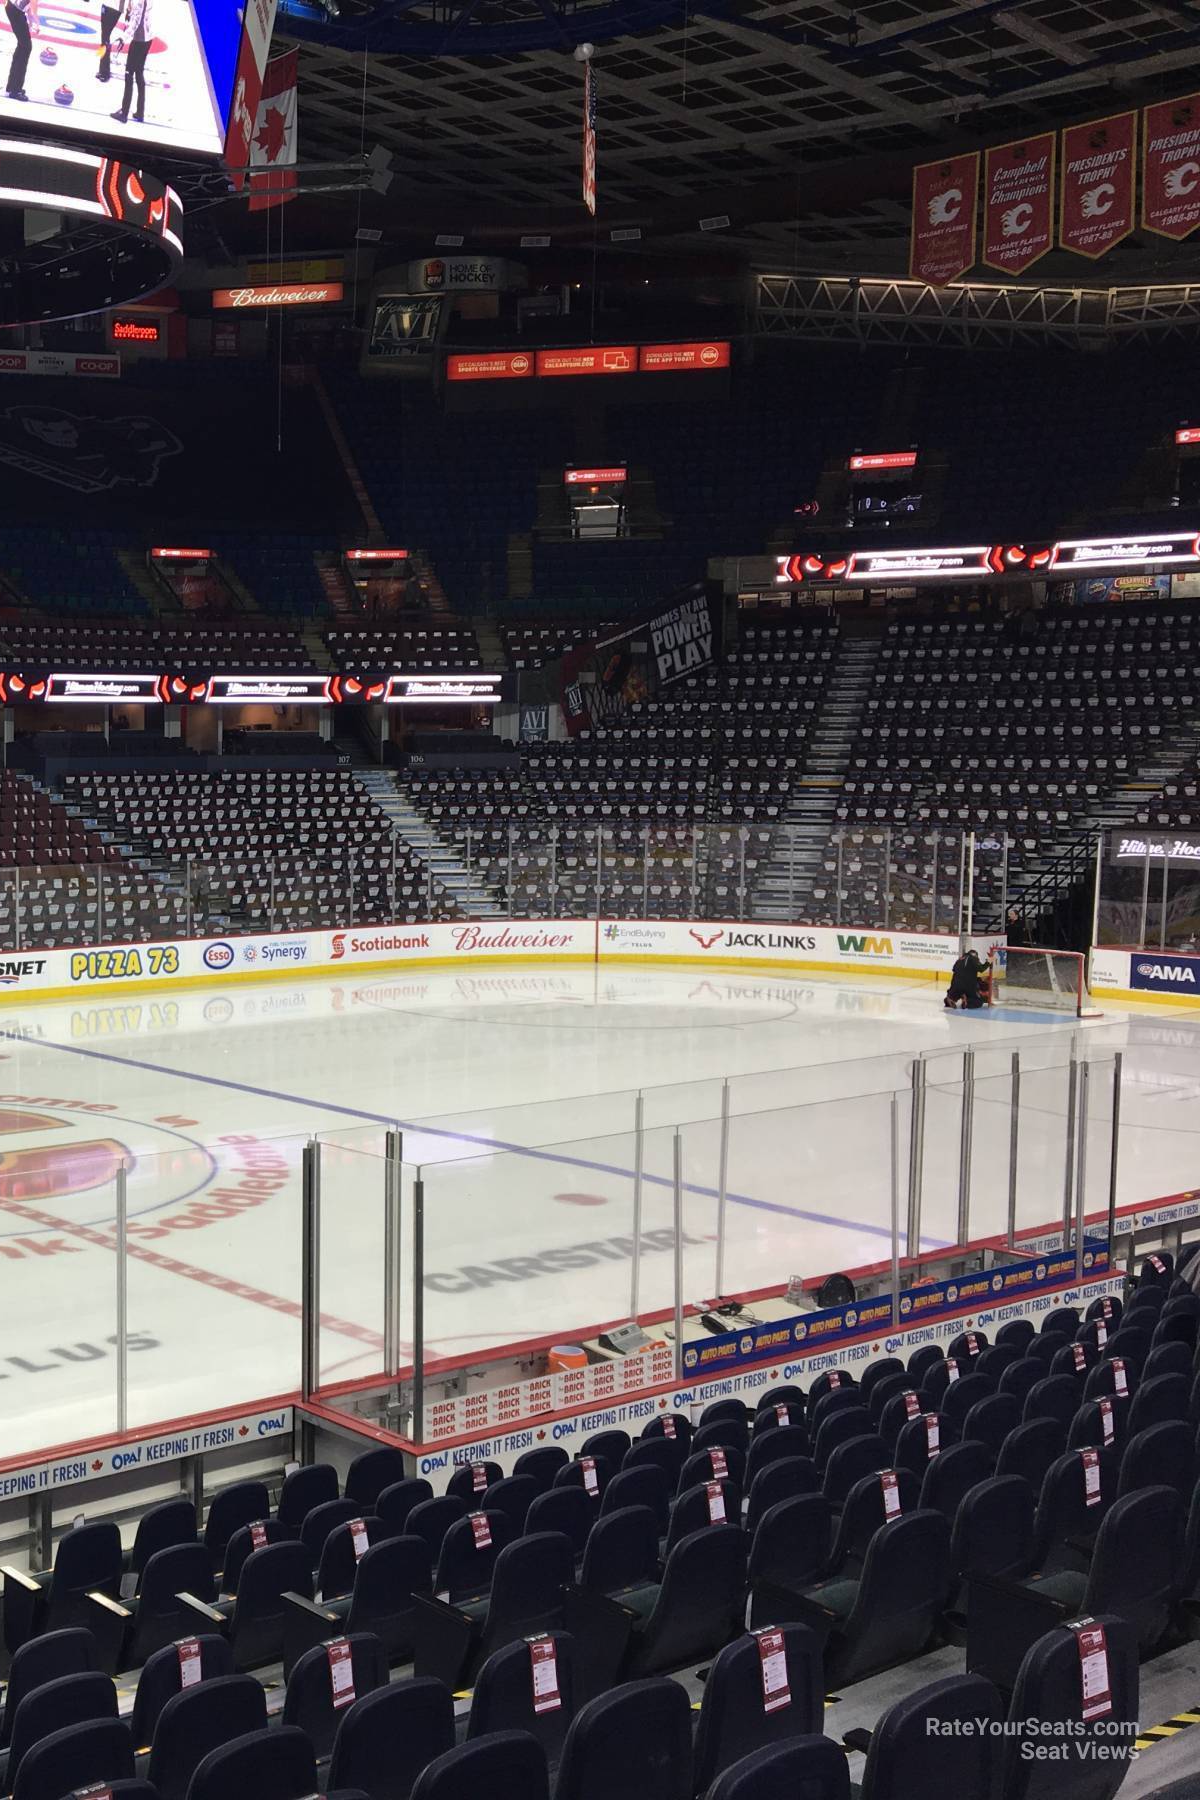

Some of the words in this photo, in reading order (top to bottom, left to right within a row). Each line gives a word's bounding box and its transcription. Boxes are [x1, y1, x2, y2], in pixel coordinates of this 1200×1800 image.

[993, 156, 1048, 182] Campbell
[1067, 148, 1128, 174] PRESIDENTS
[1078, 165, 1118, 185] TROPHY
[449, 264, 478, 273] HOME
[479, 264, 493, 273] OF
[449, 273, 495, 283] HOCKEY
[229, 287, 328, 307] Budweiser
[651, 609, 712, 656] POWER
[657, 633, 713, 680] PLAY
[522, 711, 547, 730] AVI
[350, 933, 430, 953] Scotiabank
[451, 926, 573, 951] Budweiser
[724, 932, 768, 950] JACK
[767, 933, 816, 951] LINK'S
[837, 934, 893, 955] WM
[70, 949, 141, 980] PIZZA
[148, 946, 180, 974] 73
[208, 950, 230, 961] Esso
[261, 945, 307, 961] Synergy
[1150, 964, 1196, 983] AMA
[111, 1132, 291, 1241] Saddledome
[652, 1349, 673, 1362] BRICK
[808, 1353, 838, 1373] KEEPING
[839, 1351, 847, 1364] IT
[848, 1345, 870, 1361] FRESH
[594, 1363, 615, 1376] BRICK
[498, 1386, 521, 1399] BRICK
[580, 1409, 617, 1433] KEEPING
[618, 1407, 628, 1420] IT
[628, 1399, 655, 1417] FRESH
[432, 1425, 456, 1438] BRICK
[111, 1446, 143, 1471] OPA!
[146, 1438, 189, 1462] KEEPING
[190, 1435, 202, 1449] IT
[203, 1427, 235, 1448] FRESH
